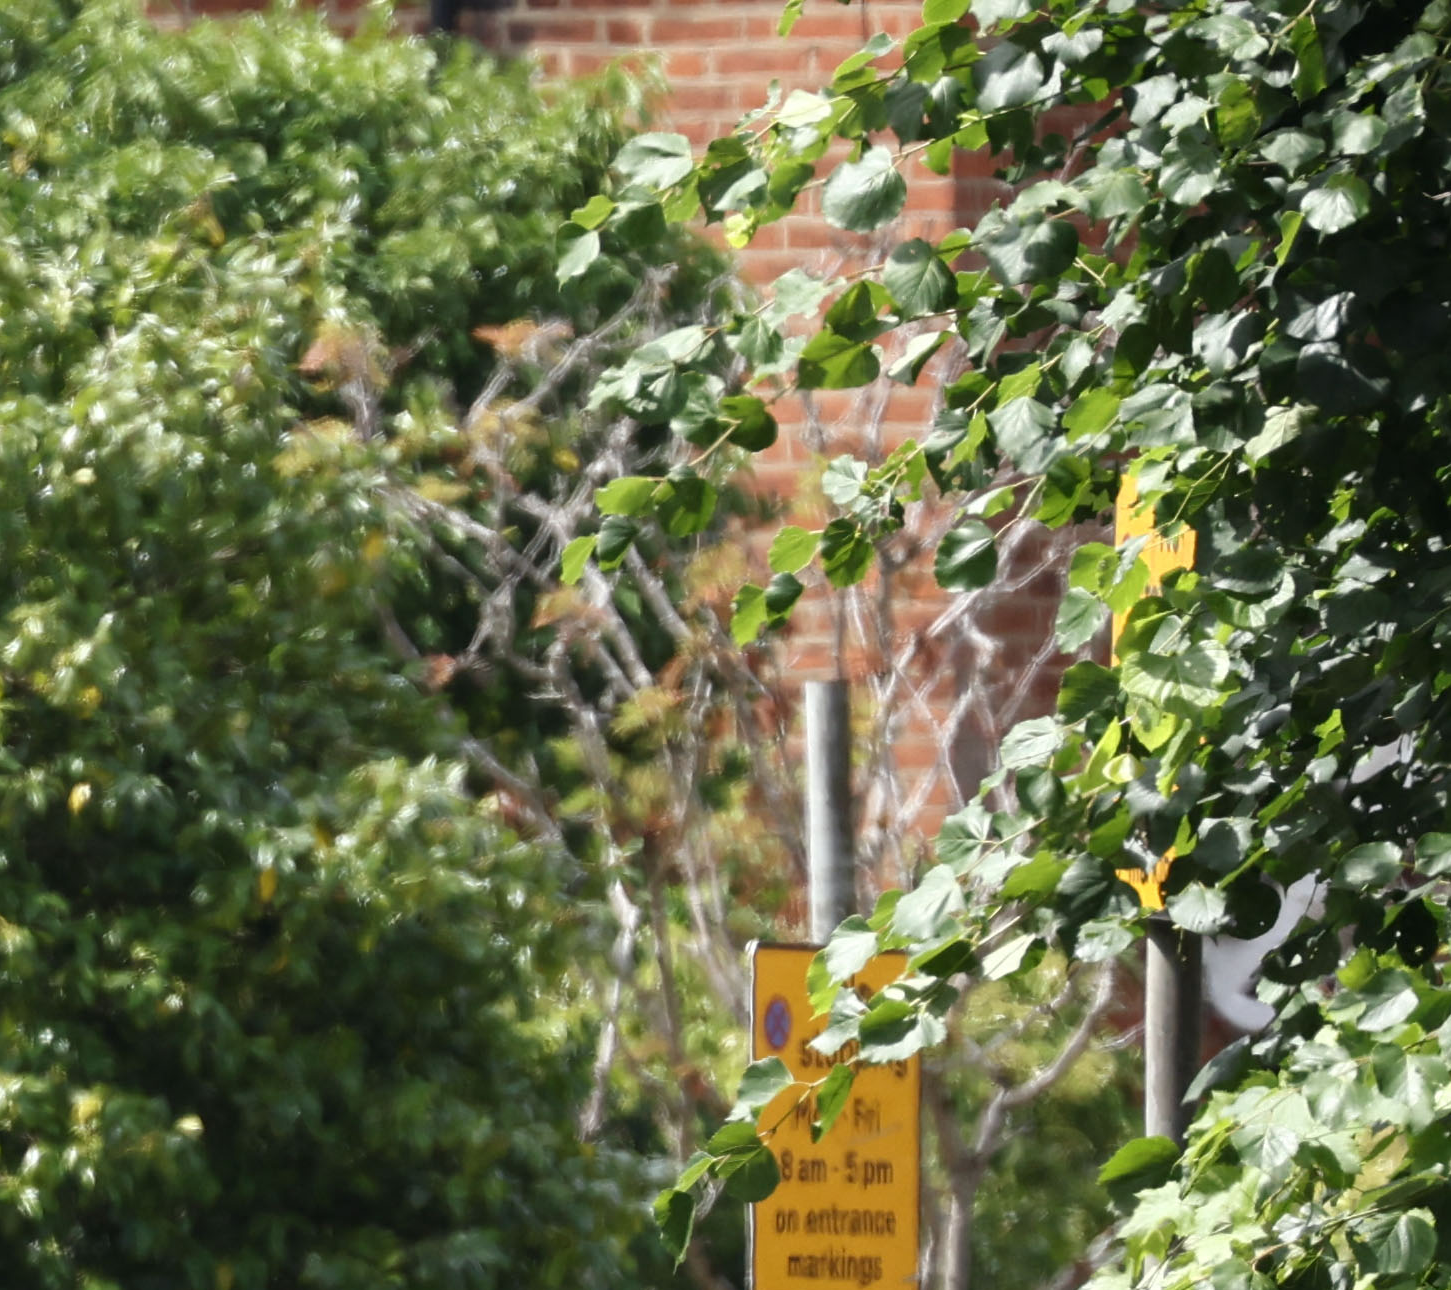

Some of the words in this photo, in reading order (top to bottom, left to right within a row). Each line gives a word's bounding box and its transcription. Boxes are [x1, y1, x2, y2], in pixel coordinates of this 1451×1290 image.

[774, 1208, 800, 1234] on
[804, 1203, 896, 1236] entrance
[787, 1246, 883, 1289] markings
